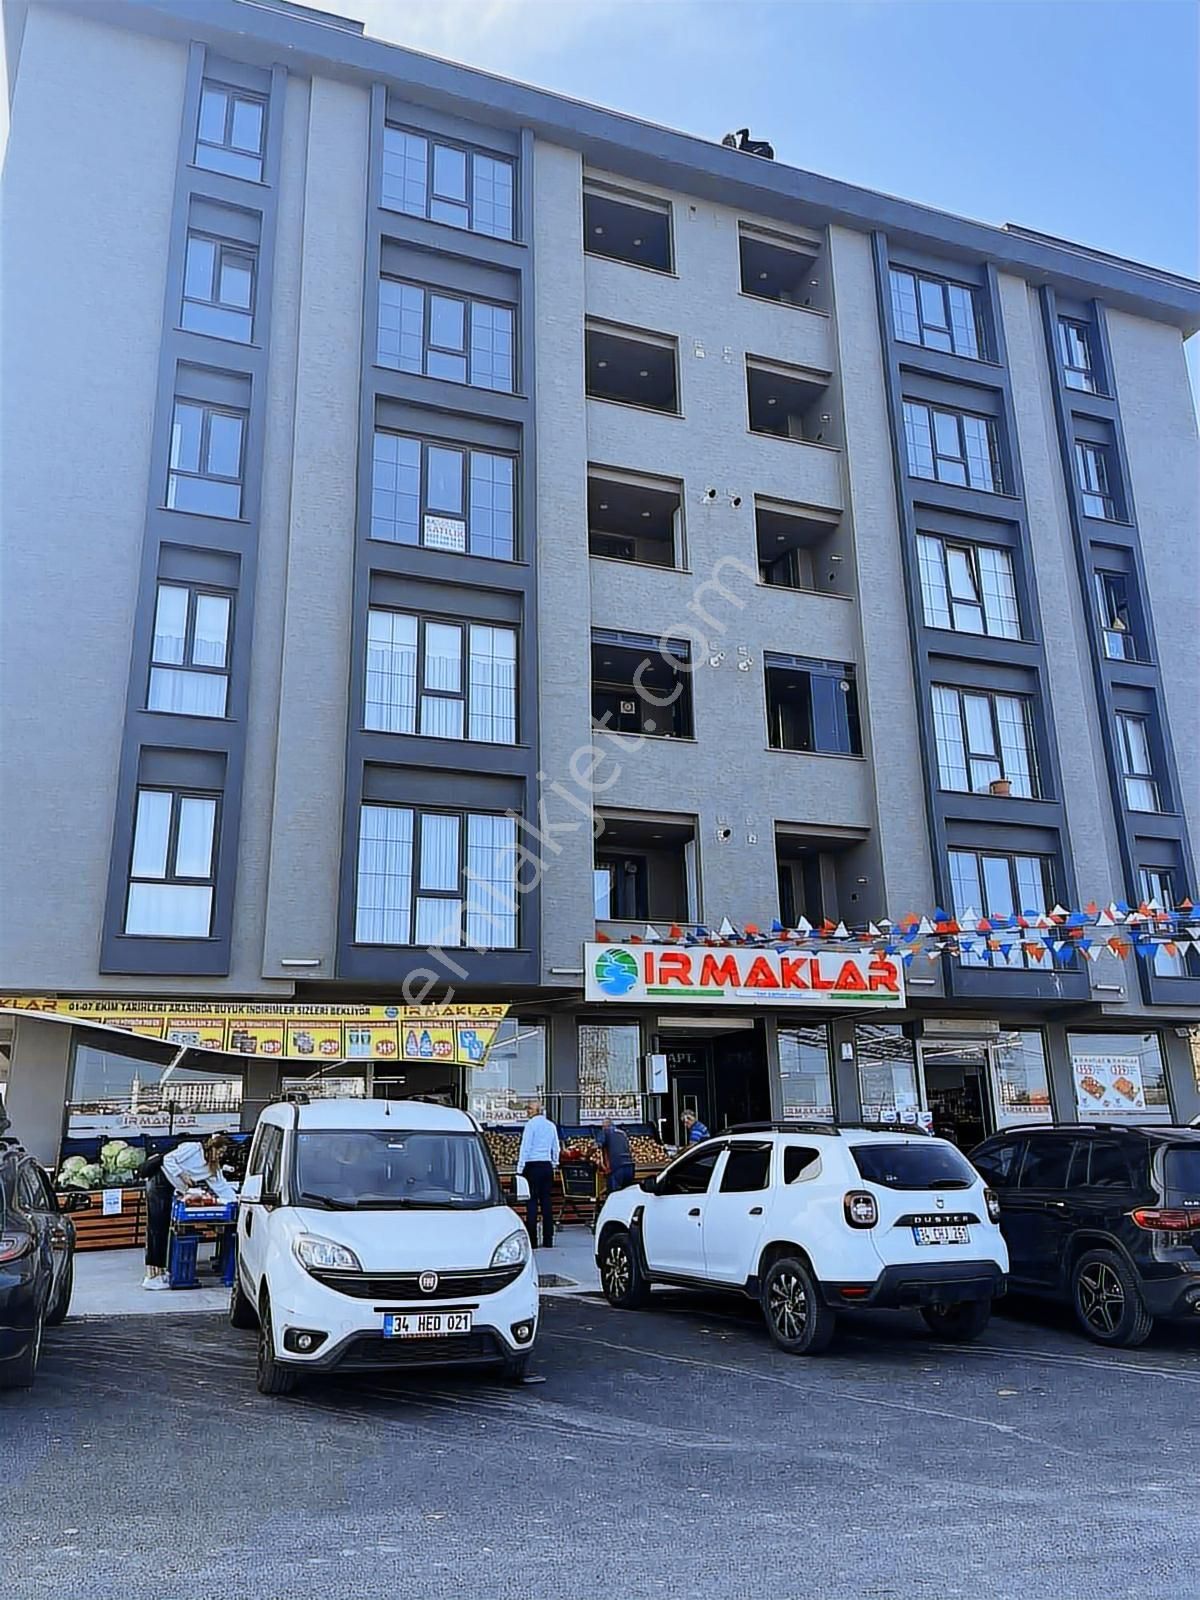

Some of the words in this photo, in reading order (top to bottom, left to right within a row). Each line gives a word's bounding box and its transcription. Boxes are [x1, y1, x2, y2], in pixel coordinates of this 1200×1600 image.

[644, 951, 900, 992] IRMAKLAR
[914, 1216, 969, 1224] DUSTER
[394, 1317, 409, 1332] 34
[418, 1316, 441, 1331] HED
[447, 1315, 468, 1330] 021
